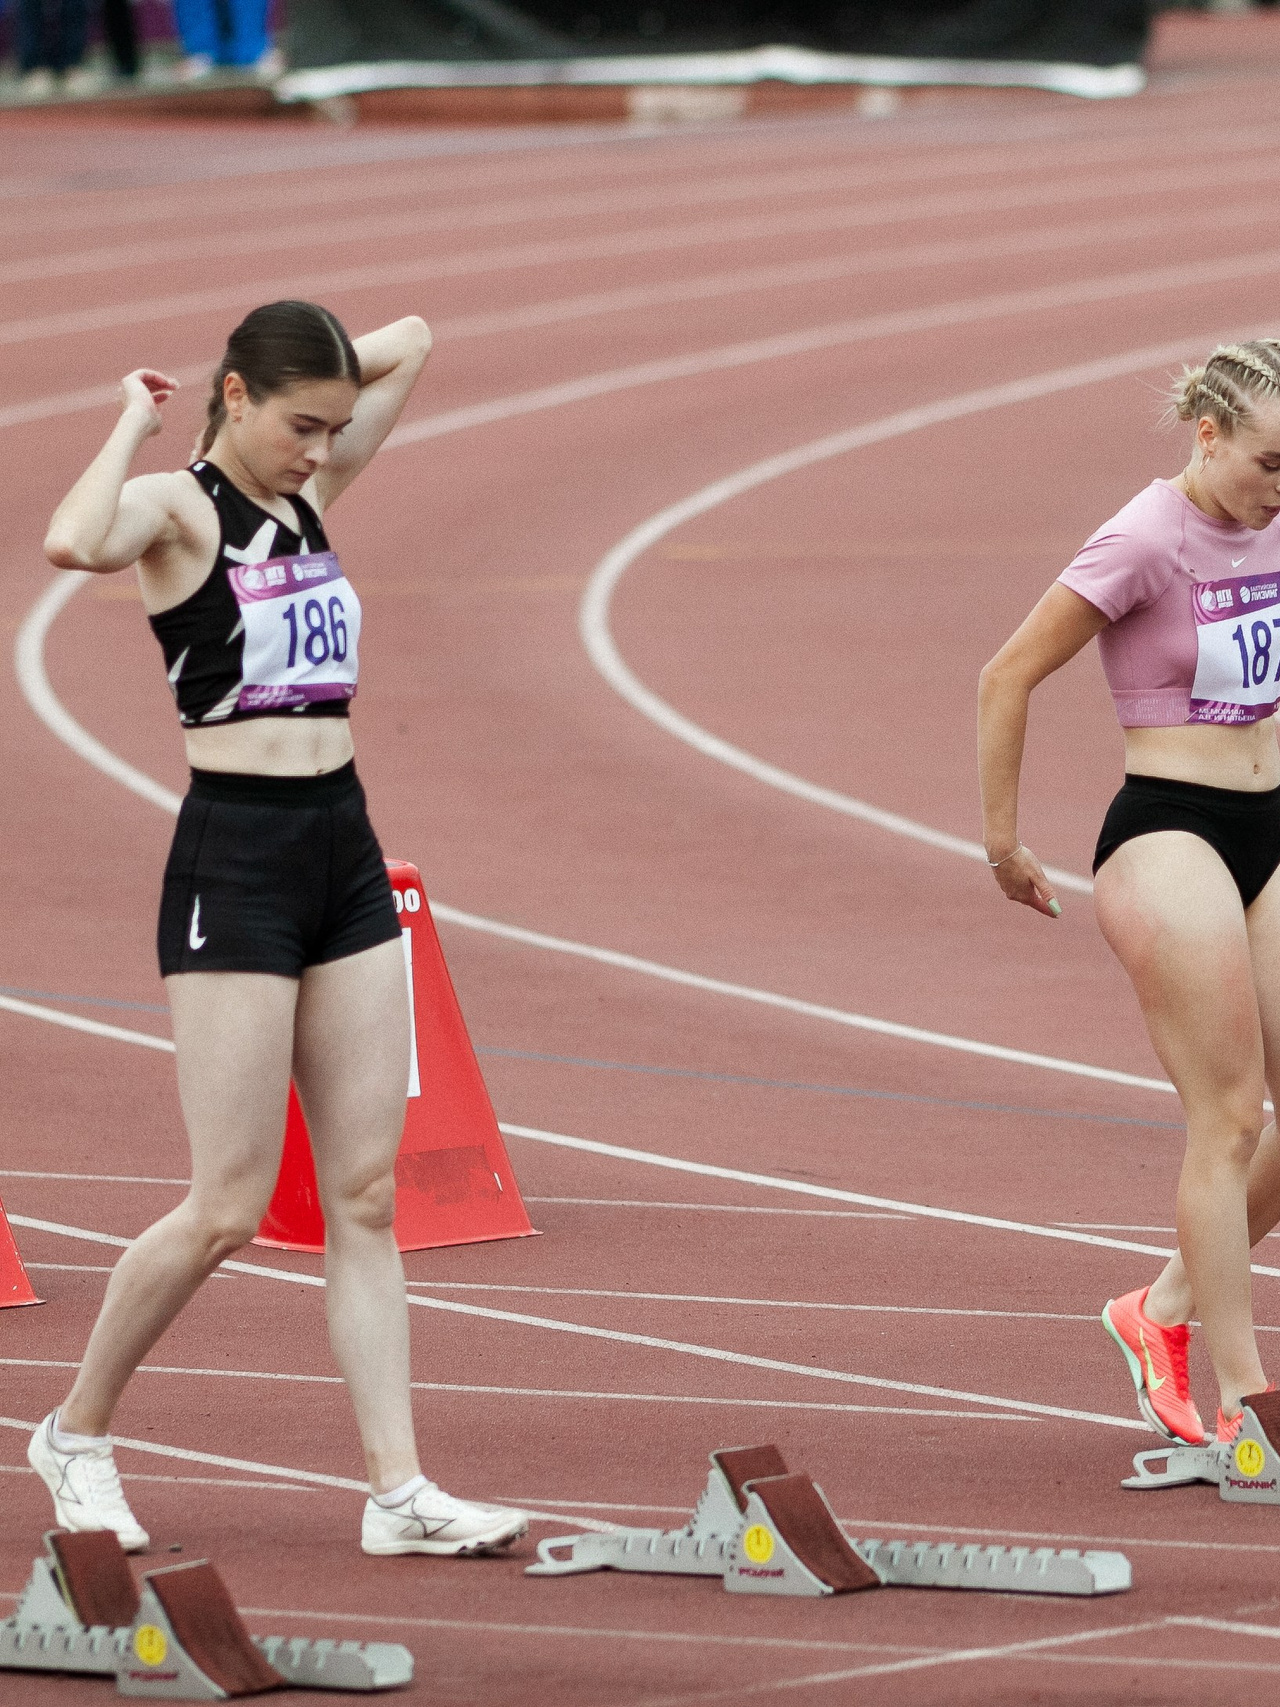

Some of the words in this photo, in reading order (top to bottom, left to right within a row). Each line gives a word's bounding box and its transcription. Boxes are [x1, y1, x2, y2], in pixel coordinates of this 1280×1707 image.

[1251, 588, 1278, 601] ЛИЗИНГ
[283, 596, 347, 667] 186
[1229, 1479, 1275, 1490] POLANIK
